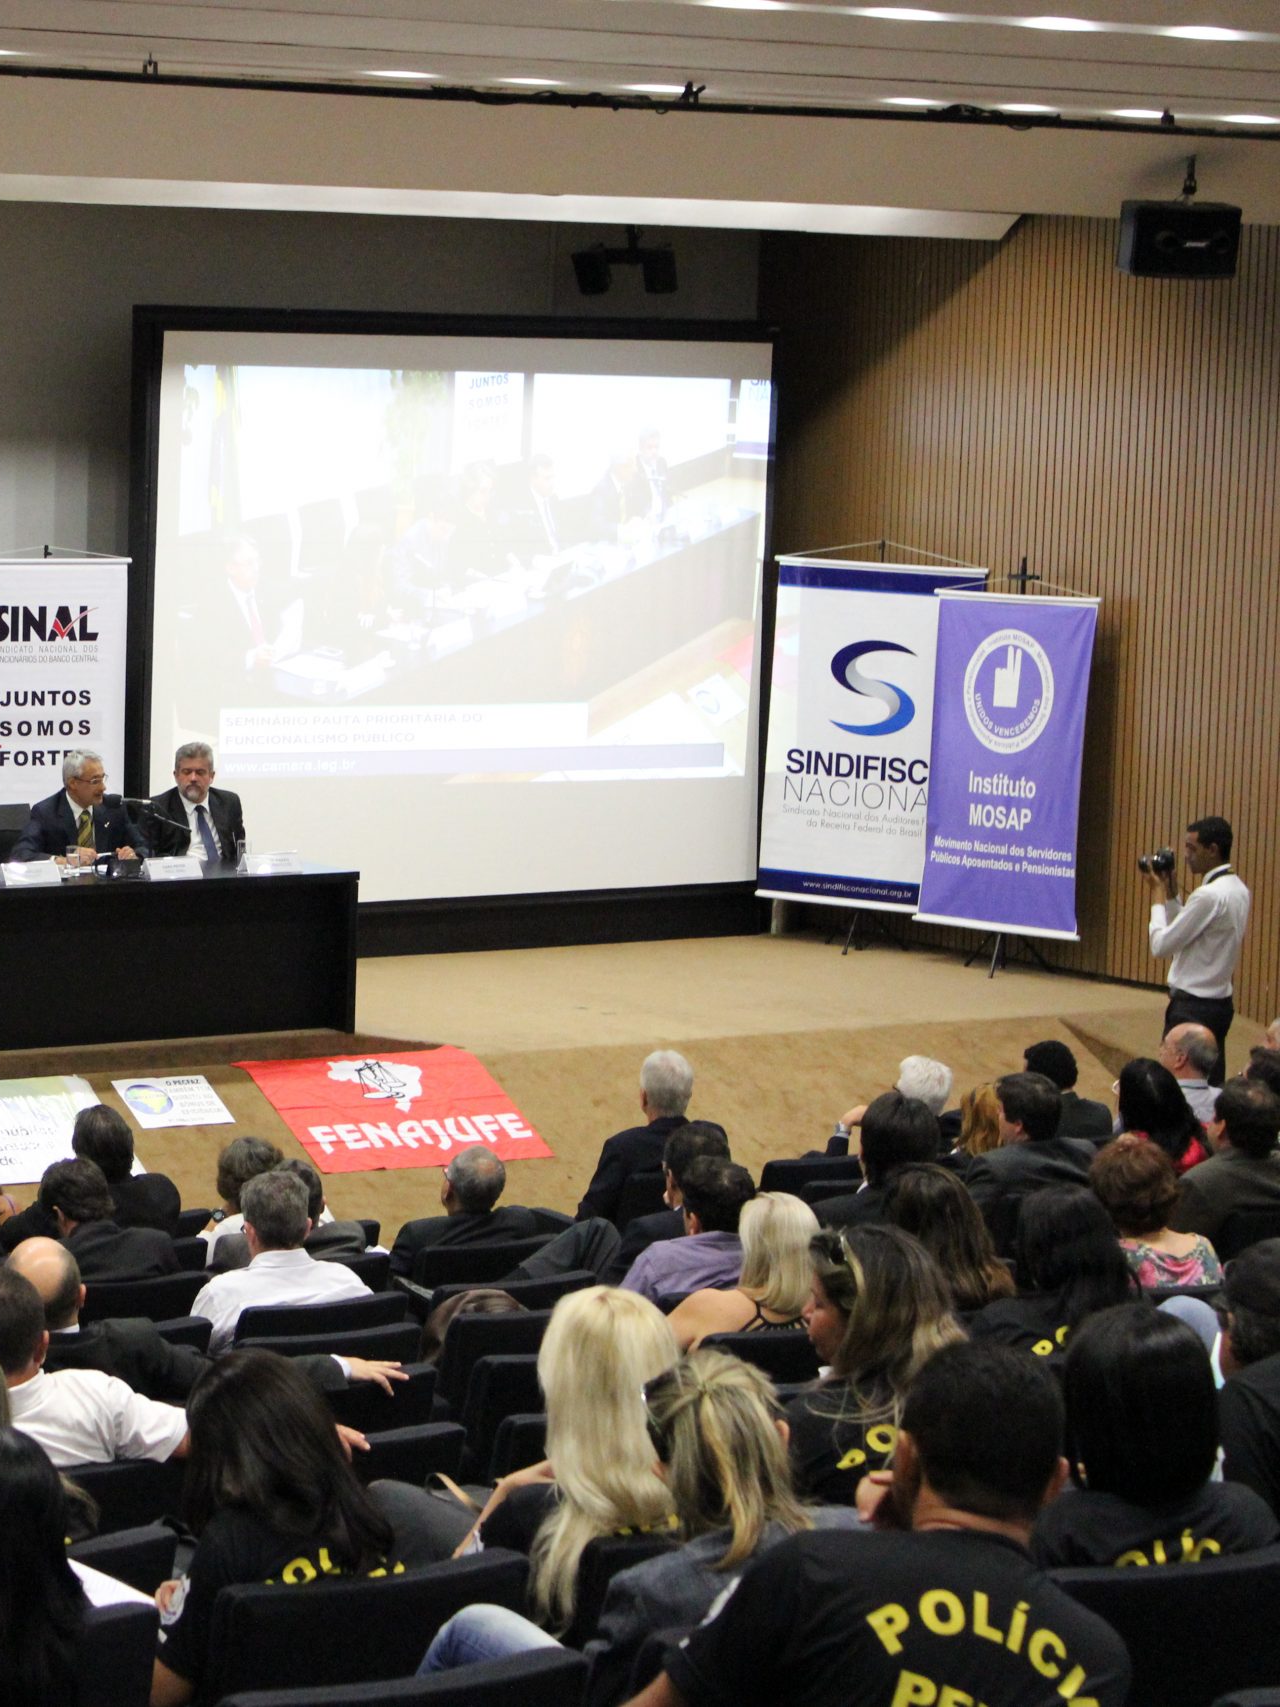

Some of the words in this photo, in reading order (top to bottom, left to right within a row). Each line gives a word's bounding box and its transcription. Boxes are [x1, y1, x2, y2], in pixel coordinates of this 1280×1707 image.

[39, 644, 77, 654] NACIONAL
[83, 644, 98, 653] DOS
[49, 655, 70, 663] BANCO
[72, 654, 98, 663] CENTRAL
[0, 690, 91, 706] JUNTOS
[313, 714, 361, 726] PAUTA
[462, 712, 483, 723] DO
[975, 693, 994, 730] UNIDOS
[994, 698, 1041, 737] VENCEREMOS
[0, 720, 91, 736] SOMOS
[225, 733, 349, 746] FUNCIONALISMO
[0, 750, 73, 766] FORT
[786, 749, 928, 785] SINDIFISC
[784, 776, 927, 813] NACIONA
[969, 771, 1036, 798] Instituto
[782, 805, 820, 816] Sindicato
[823, 808, 862, 820] Nacional
[864, 813, 879, 823] dos
[969, 804, 1031, 831] MOSAP
[821, 820, 851, 831] Receita
[853, 822, 884, 834] Federal
[934, 835, 972, 850] Movimento
[974, 840, 1008, 855] Nacional
[1010, 844, 1024, 857] dos
[1027, 846, 1072, 862] Servidores
[930, 851, 960, 865] Públicos
[961, 855, 1013, 871] Aposentados
[1015, 864, 1020, 872] e
[1022, 861, 1076, 878] Pensionistas
[308, 1113, 532, 1155] FENAJUFE
[866, 1588, 1101, 1707] POLÍCI
